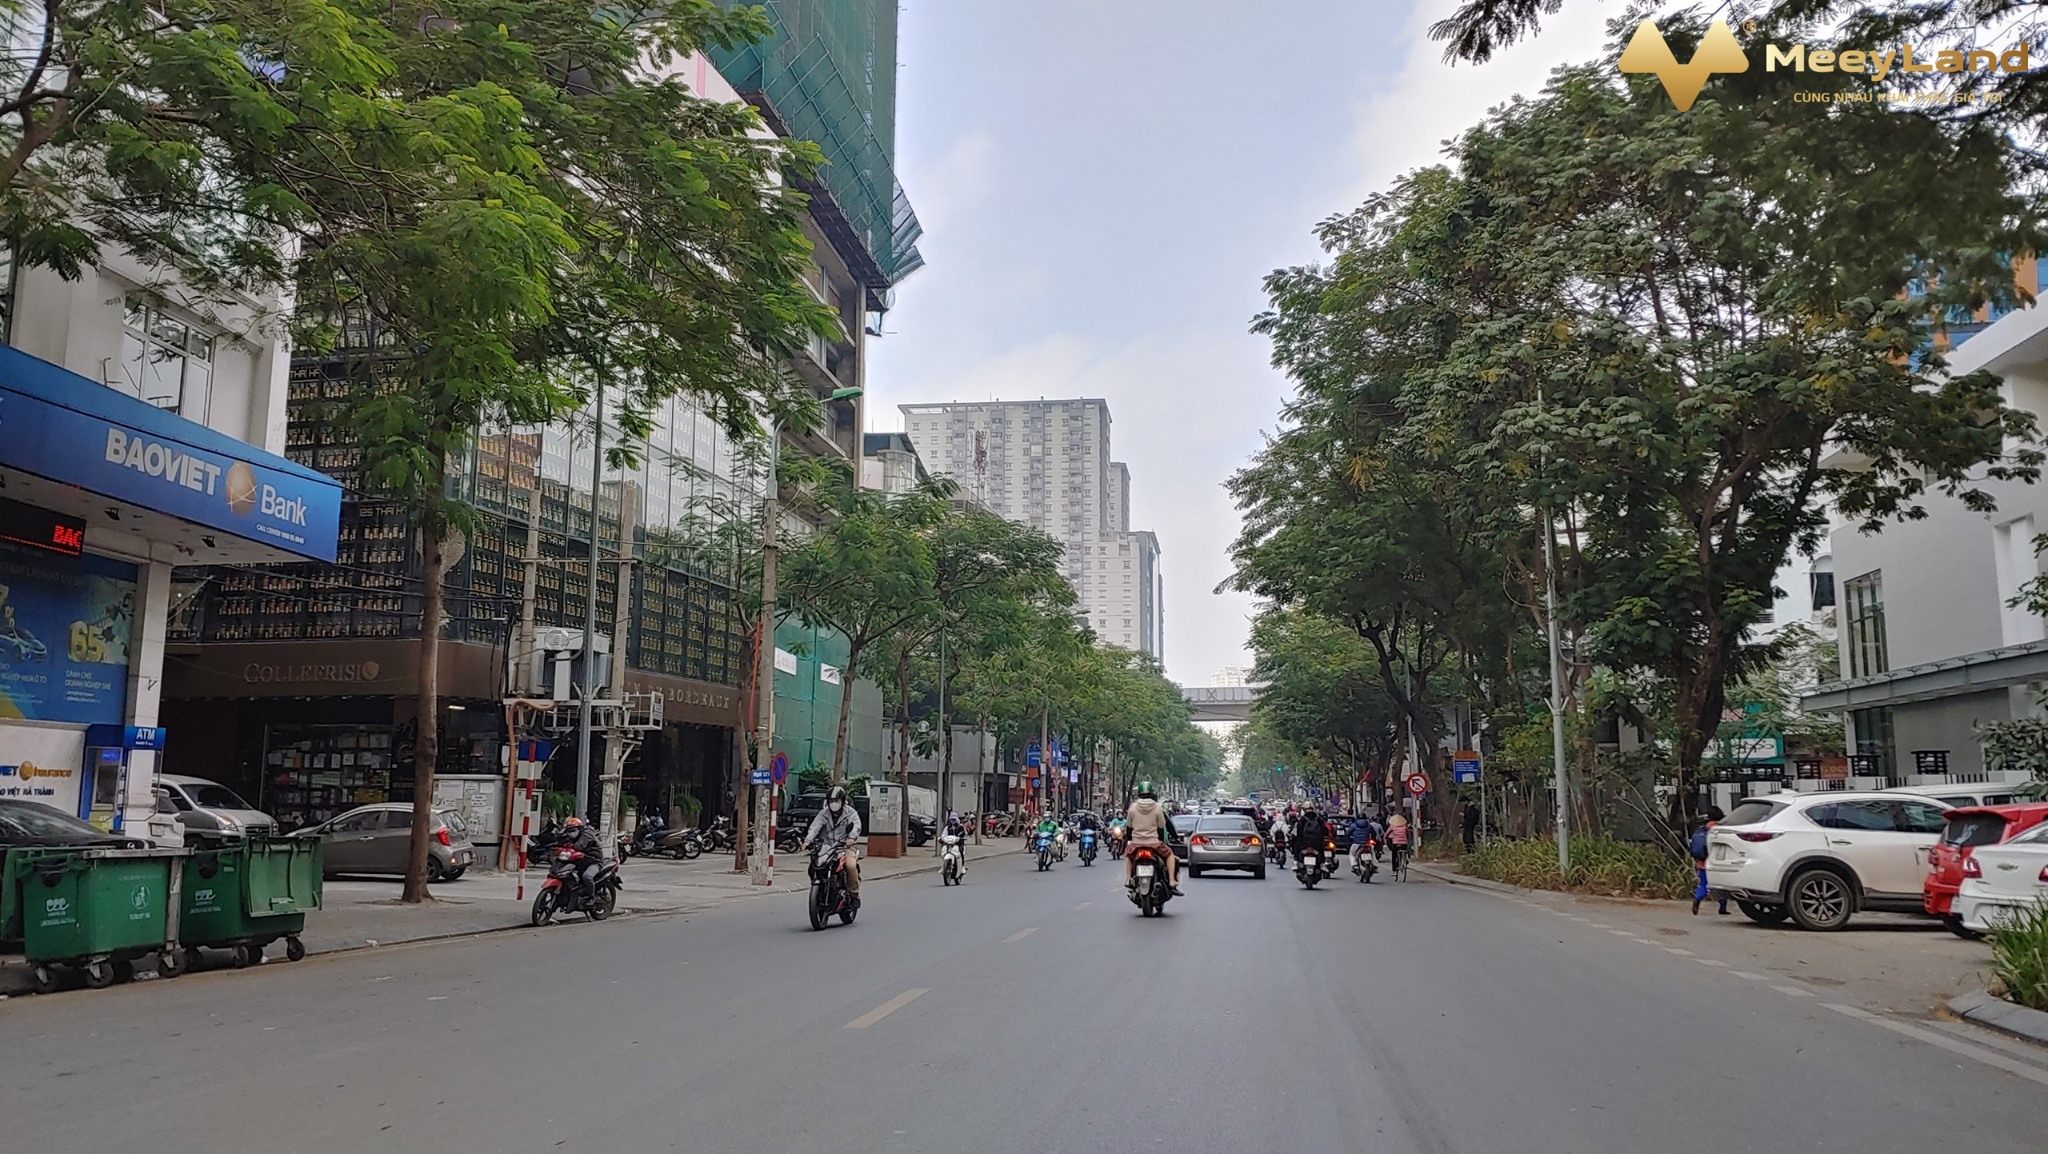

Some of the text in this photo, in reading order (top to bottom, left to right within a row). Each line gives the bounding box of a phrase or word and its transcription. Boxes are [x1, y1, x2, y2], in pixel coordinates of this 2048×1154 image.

[105, 428, 307, 527] BAOVIET Bank
[136, 728, 155, 740] ATM
